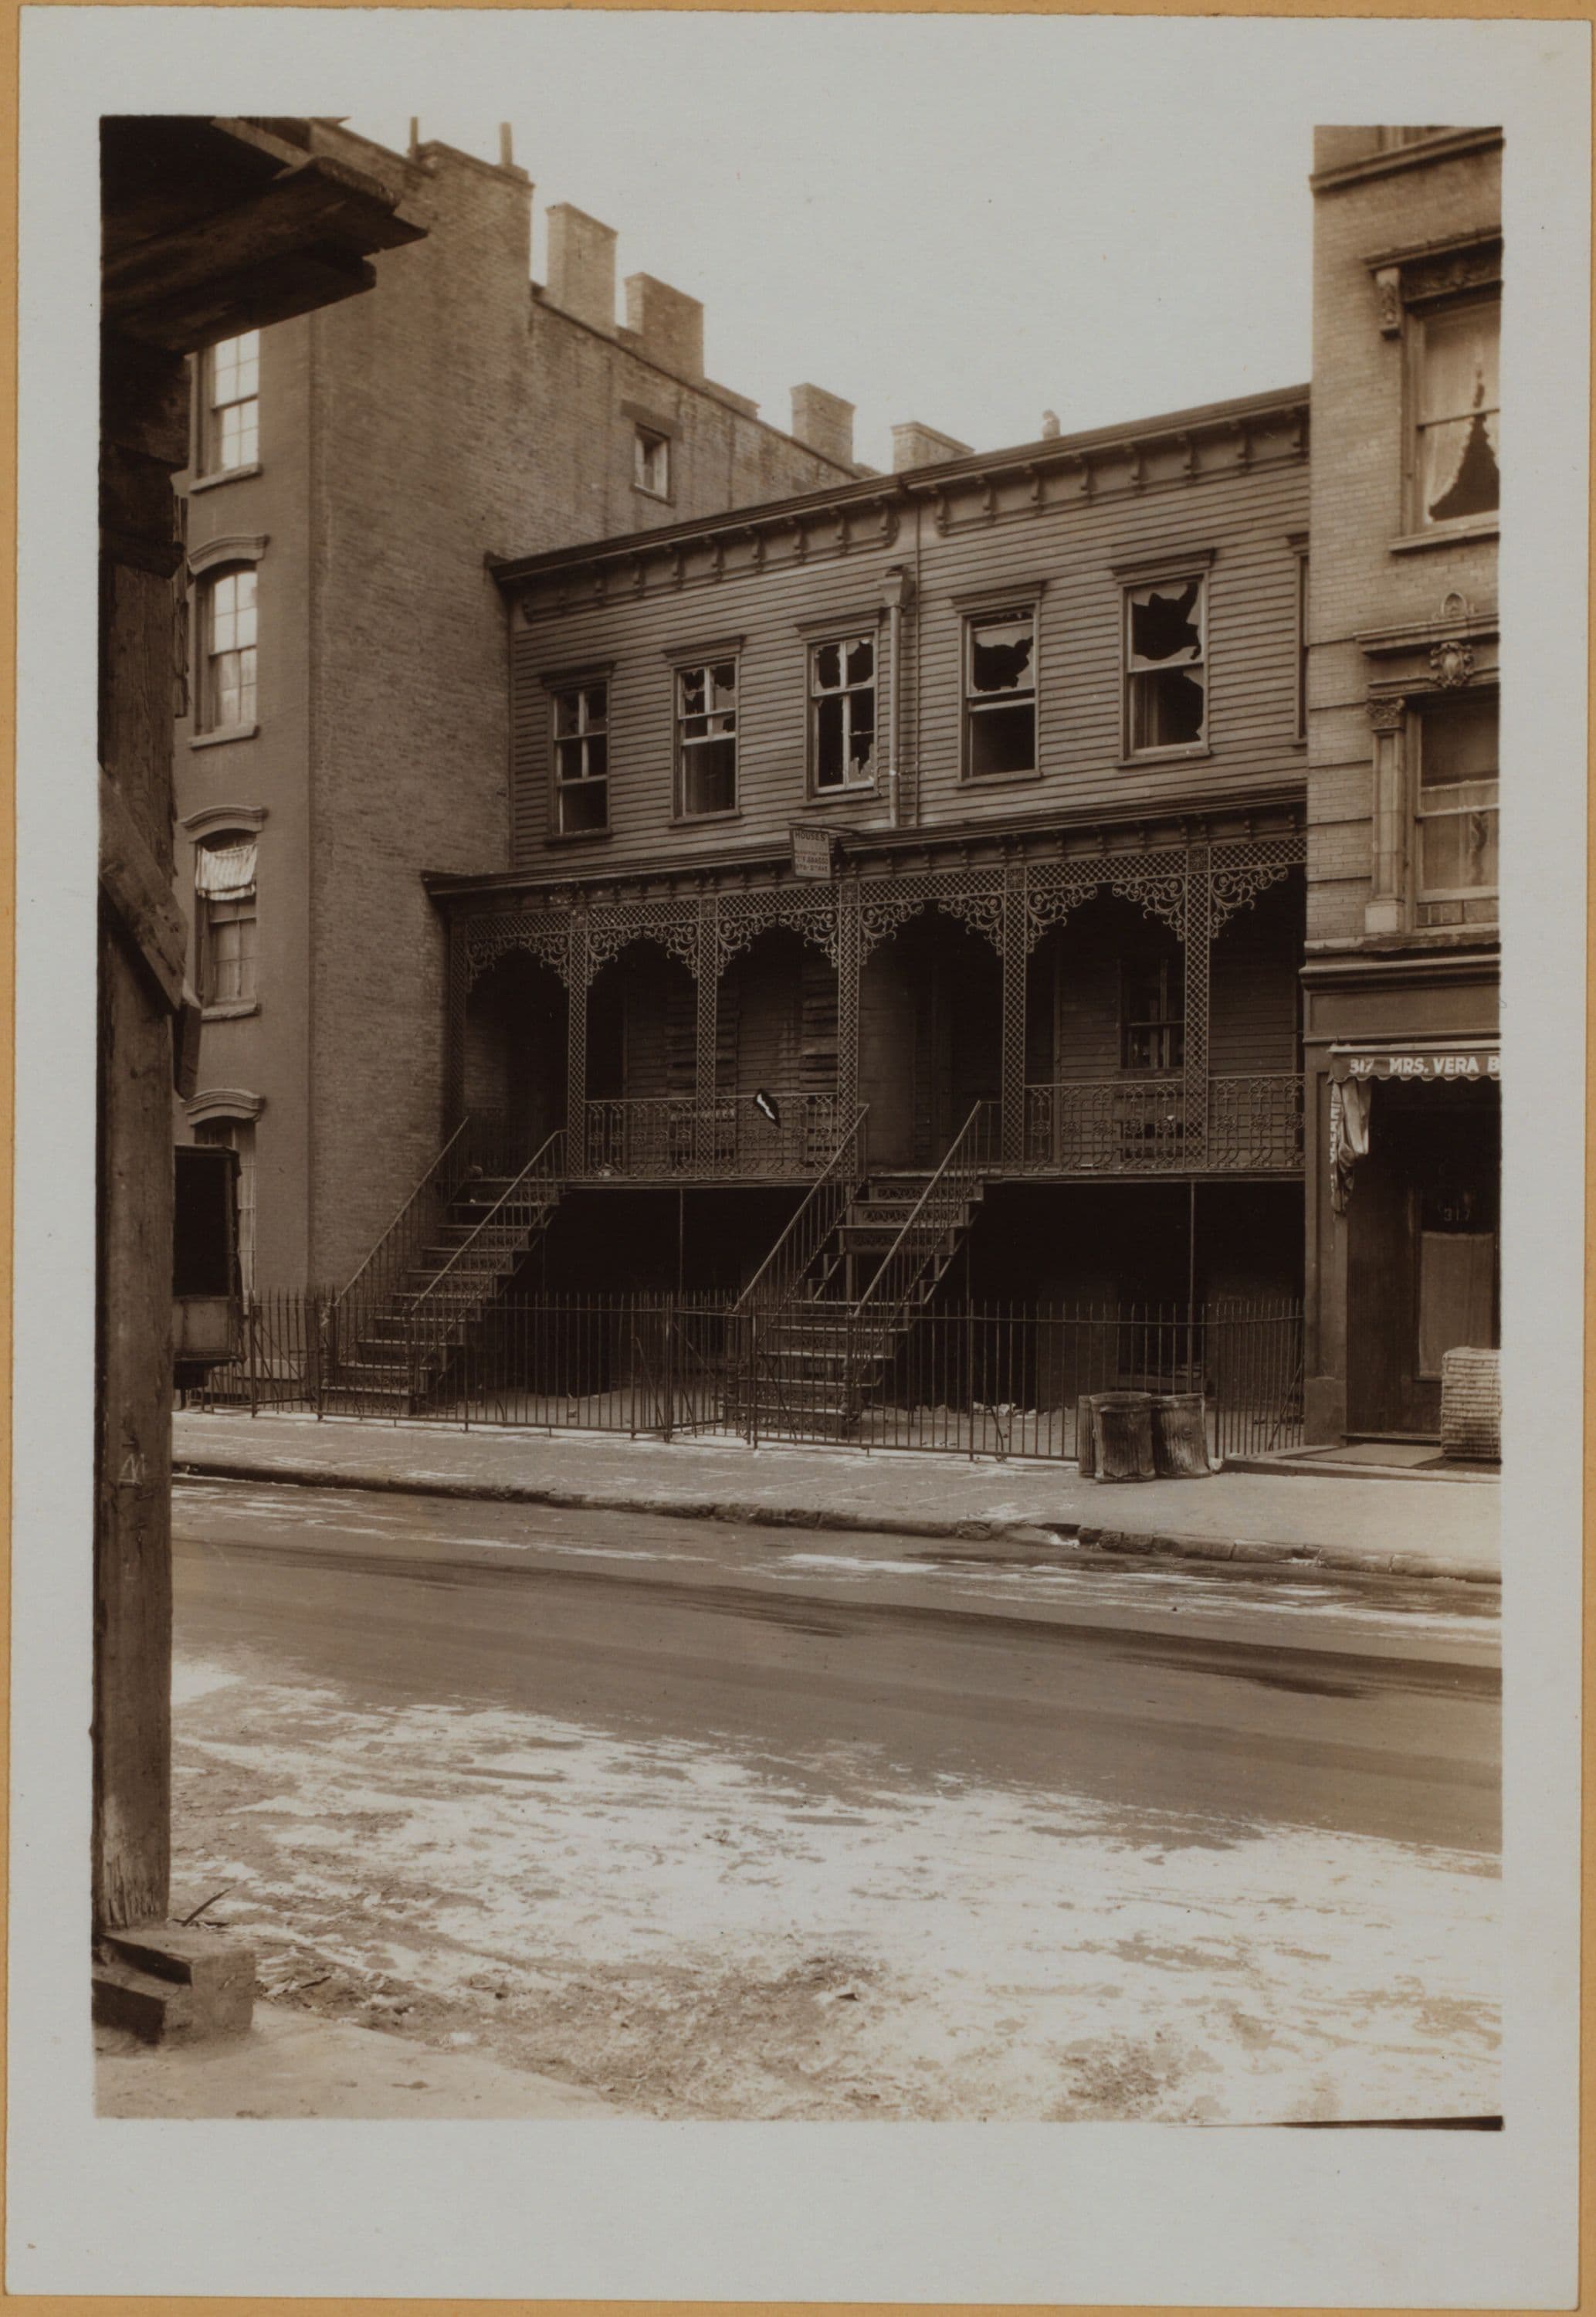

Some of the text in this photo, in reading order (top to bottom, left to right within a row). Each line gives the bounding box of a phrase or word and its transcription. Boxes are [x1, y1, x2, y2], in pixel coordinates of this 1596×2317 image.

[795, 830, 826, 842] HOUSES
[1349, 1058, 1374, 1074] 317
[1389, 1057, 1428, 1074] MRS.
[1433, 1056, 1479, 1074] VERA
[1444, 1208, 1471, 1221] 317
